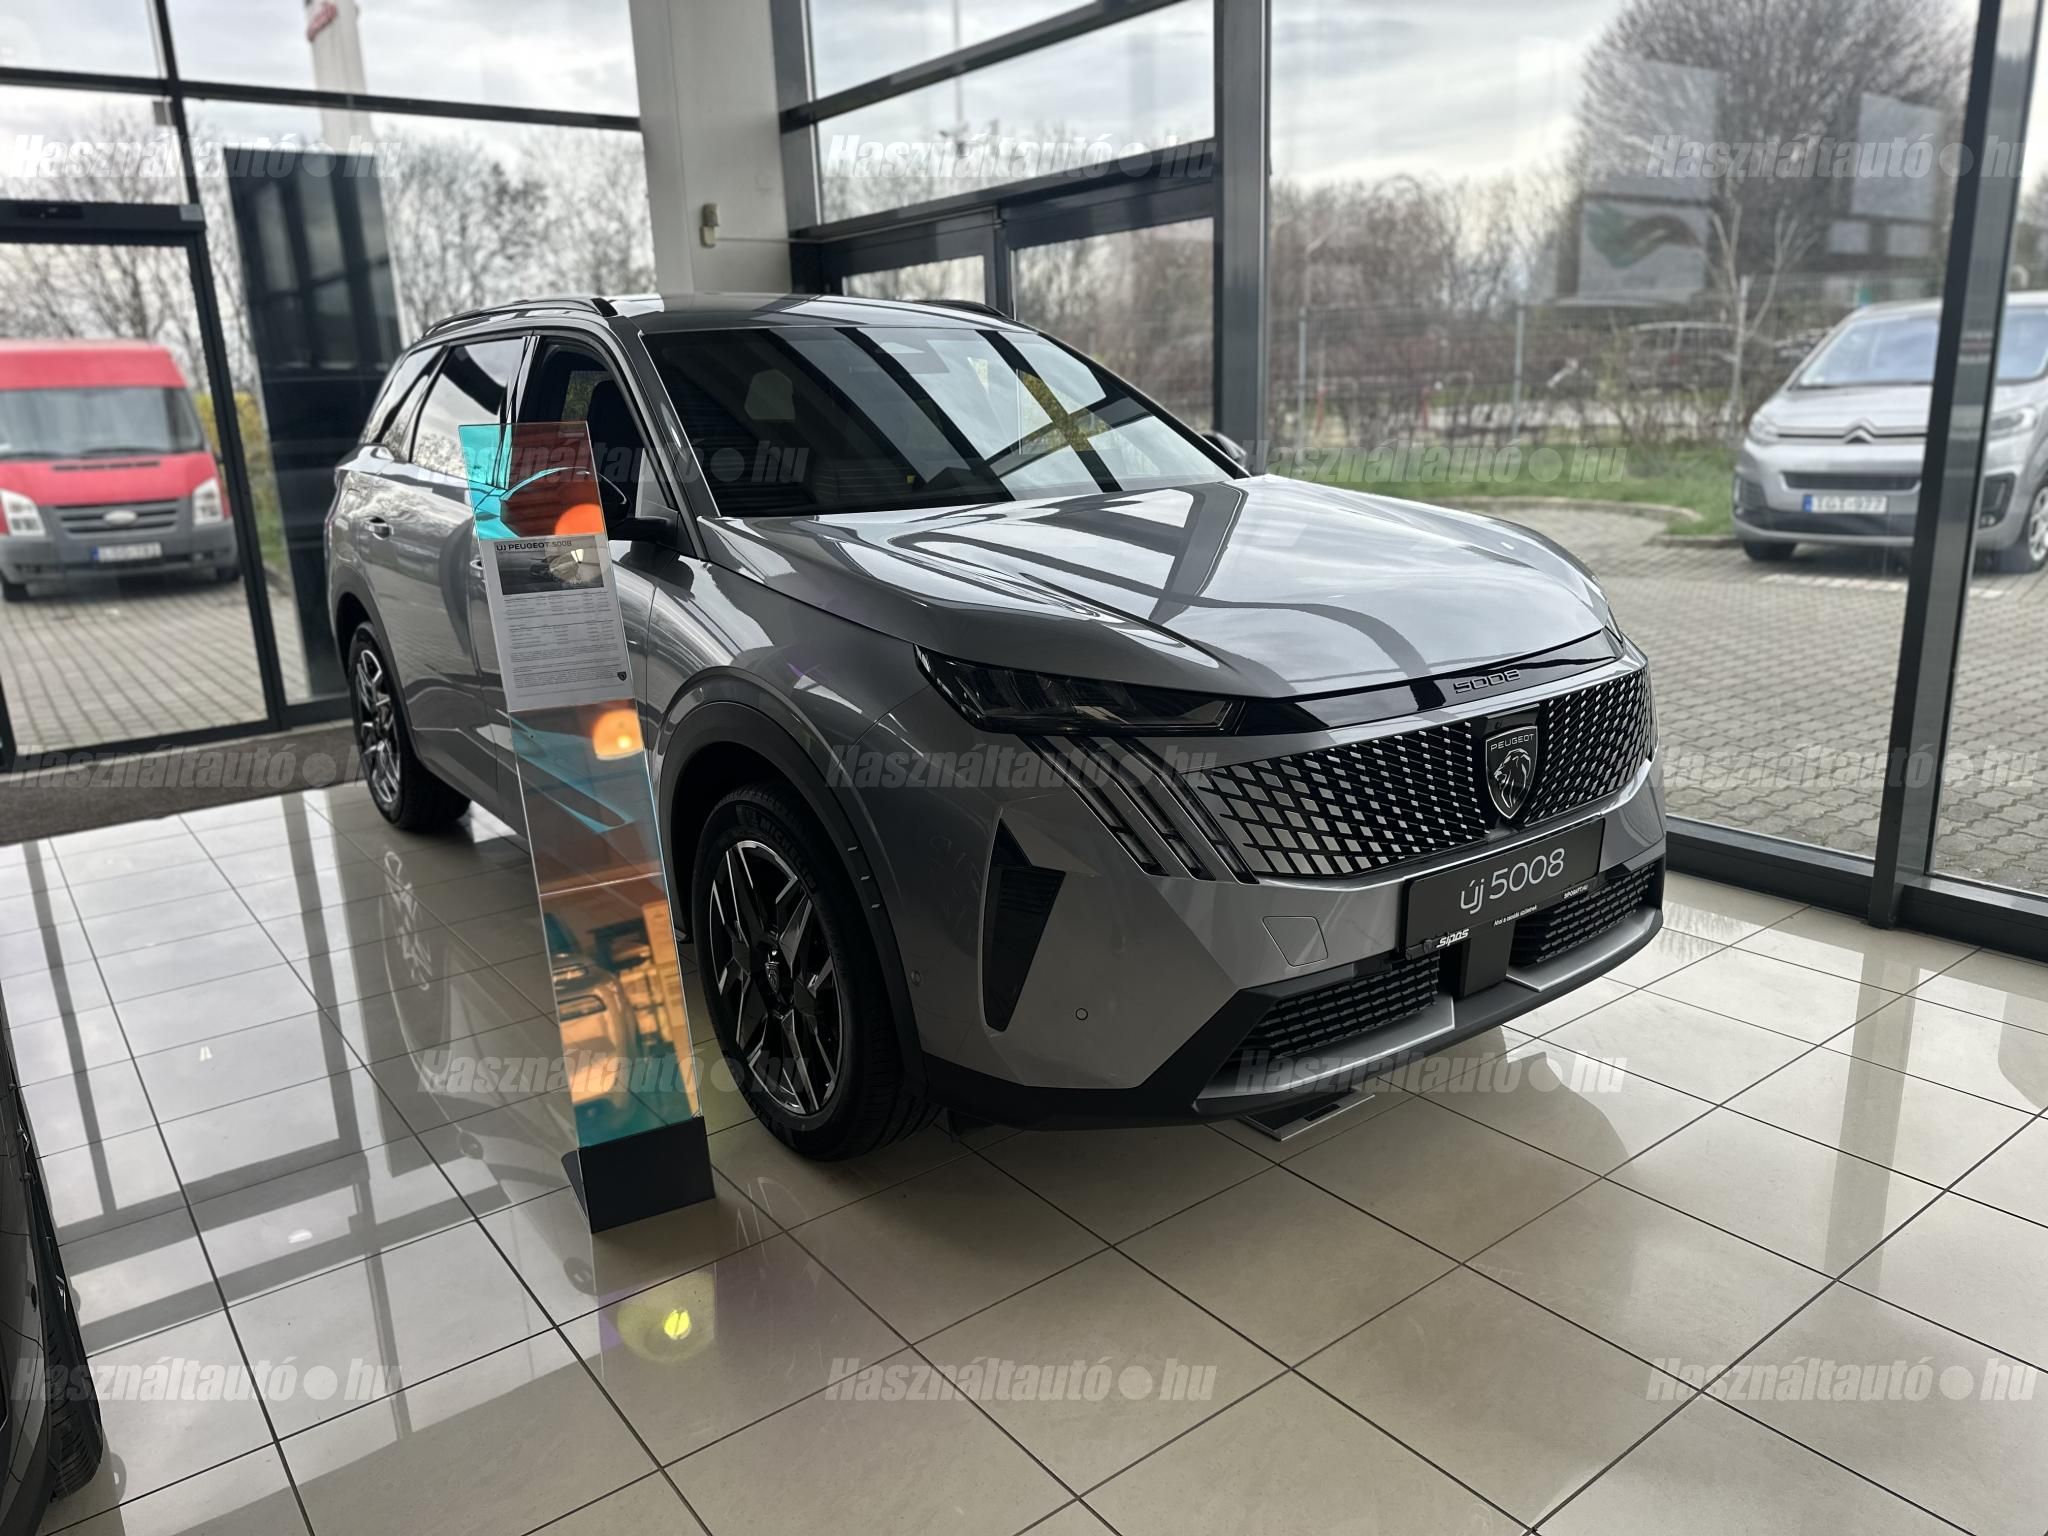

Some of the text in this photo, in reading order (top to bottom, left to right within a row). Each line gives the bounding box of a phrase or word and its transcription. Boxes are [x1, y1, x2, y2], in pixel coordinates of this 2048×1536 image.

[508, 542, 549, 551] PEUGEOT
[1453, 669, 1520, 694] 5008
[1490, 733, 1535, 751] PEUGEOT
[1460, 848, 1565, 915] új 5008
